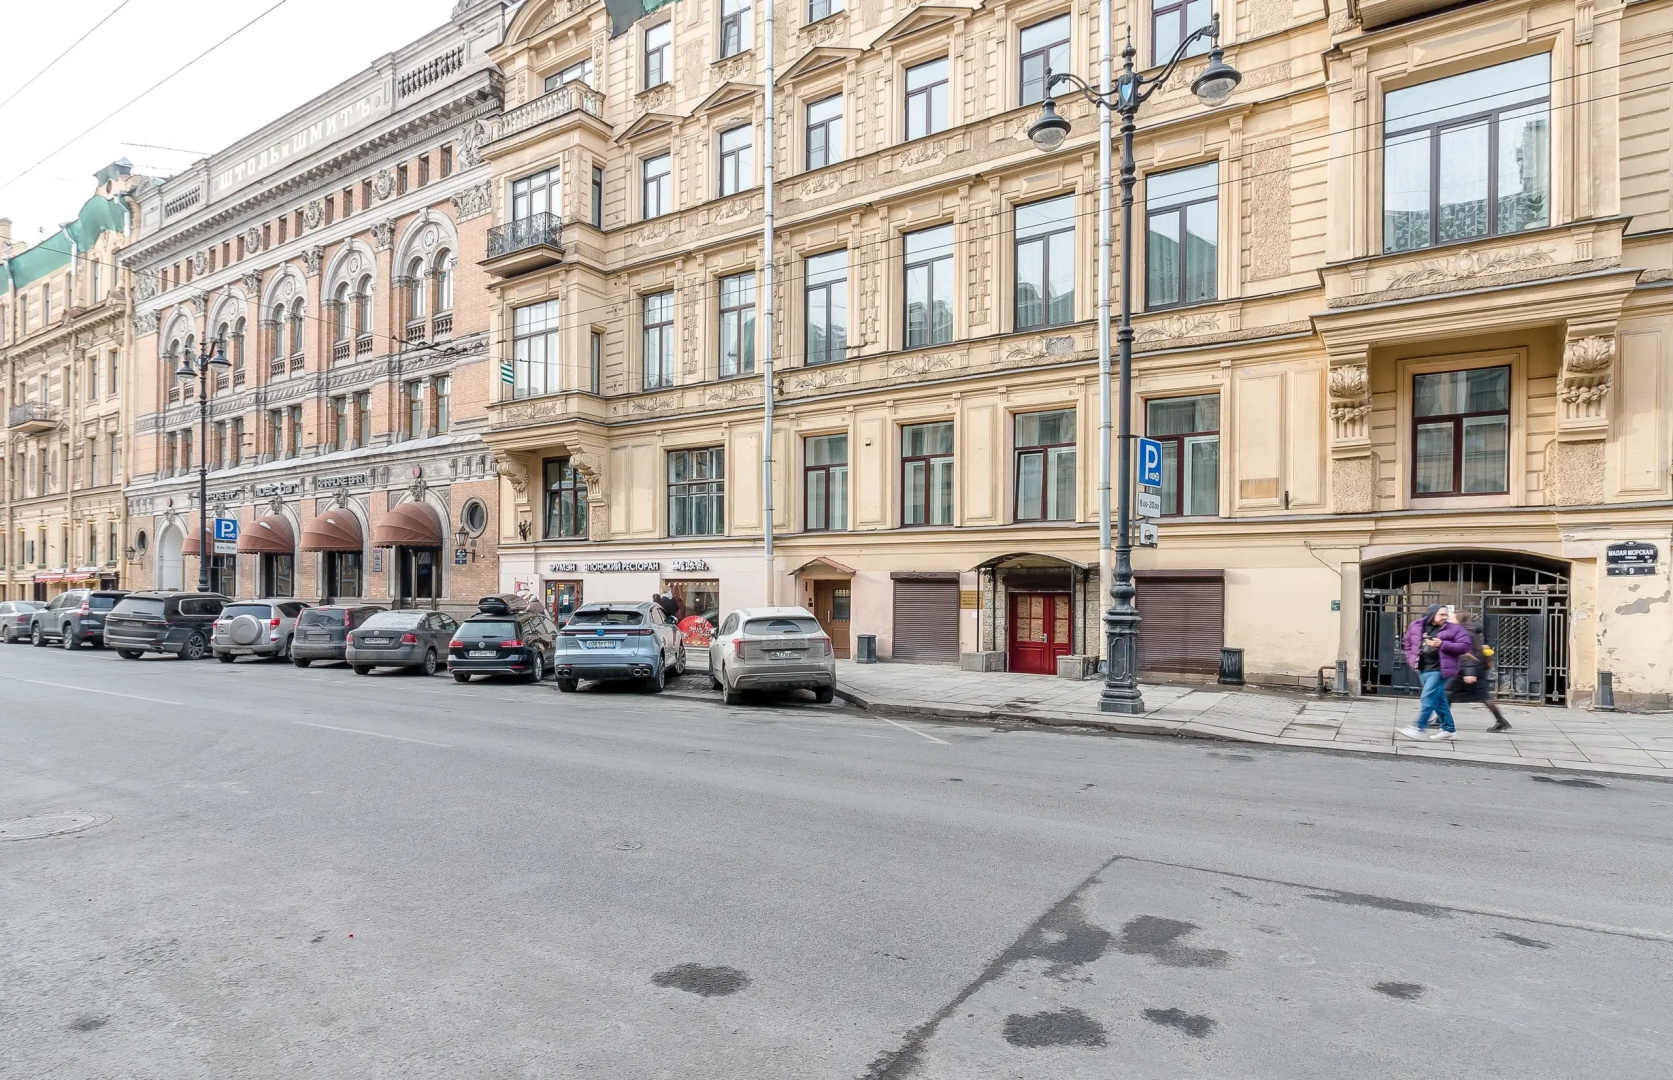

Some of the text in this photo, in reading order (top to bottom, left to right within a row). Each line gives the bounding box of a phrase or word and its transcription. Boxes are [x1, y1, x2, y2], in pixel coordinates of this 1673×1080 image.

[220, 146, 279, 190] ШТОЛЬ
[293, 100, 371, 151] ШМИТЪ
[1145, 444, 1158, 480] P
[318, 474, 364, 488] KARAOKE BAR
[221, 520, 234, 538] P
[1608, 549, 1627, 557] МАЛАЯ
[621, 561, 660, 571] РЕСТОРАН
